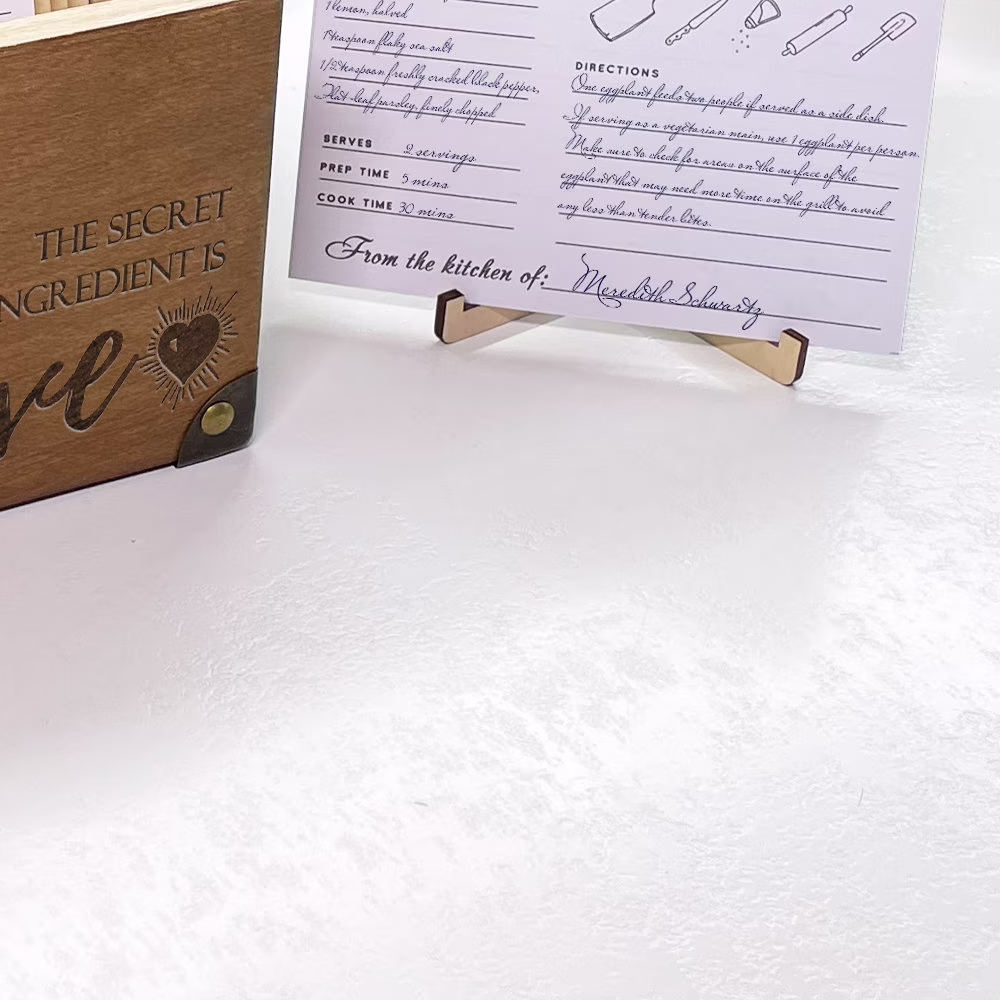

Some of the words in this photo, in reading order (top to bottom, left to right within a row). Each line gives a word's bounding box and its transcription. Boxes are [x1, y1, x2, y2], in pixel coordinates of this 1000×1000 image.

[372, 0, 414, 19] halved
[328, 29, 376, 51] teaspoon
[372, 30, 406, 58] flaky
[410, 43, 426, 51] sea
[429, 37, 454, 54] salt
[320, 57, 338, 72] 1/2
[338, 60, 385, 82] teaspoon
[382, 61, 426, 90] freshly
[428, 68, 474, 85] cracked
[471, 70, 504, 89] black
[496, 80, 540, 99] pepper,
[575, 61, 660, 78] DIRECTIONS
[415, 95, 453, 122] finely
[455, 100, 502, 125] chopped
[570, 72, 598, 91] One
[598, 80, 653, 104] eggplant
[646, 83, 684, 108] feeds
[684, 90, 706, 103] two
[701, 91, 745, 115] people
[743, 93, 763, 119] if
[759, 98, 805, 113] served
[829, 103, 855, 120] side
[562, 102, 591, 130] If
[588, 116, 633, 136] serving
[663, 121, 725, 141] vegetarian
[728, 131, 764, 141] main,
[797, 133, 854, 156] eggplant
[846, 141, 872, 159] per
[869, 144, 920, 162] person.
[323, 134, 372, 148] SERVES
[403, 143, 413, 155] 2
[416, 149, 476, 172] servings
[565, 128, 603, 160] Make
[606, 148, 632, 156] sure
[633, 146, 646, 159] to
[649, 145, 683, 162] check
[675, 147, 700, 172] for
[702, 160, 736, 168] areas
[737, 163, 753, 171] on
[755, 156, 775, 173] the
[778, 160, 821, 186] surface
[823, 165, 842, 189] of
[838, 166, 858, 182] the
[320, 162, 352, 174] PREP
[360, 167, 390, 179] TIME
[401, 173, 409, 184] 5
[412, 177, 449, 189] mins
[560, 166, 610, 190] eggplant
[610, 170, 641, 188] that
[641, 183, 668, 201] may
[671, 179, 704, 195] need
[701, 189, 731, 199] more
[733, 187, 763, 202] time
[766, 196, 781, 204] on
[782, 190, 803, 207] the
[799, 194, 840, 218] grill
[834, 200, 847, 211] to
[851, 201, 892, 216] avoid
[35, 220, 99, 262] THE
[107, 187, 233, 246] SECRET
[317, 193, 355, 206] COOK
[363, 199, 393, 210] TIME
[399, 202, 415, 214] 30
[417, 208, 455, 220] mins
[557, 202, 579, 220] any
[582, 197, 605, 214] less
[606, 200, 637, 216] than
[637, 206, 676, 222] tender
[680, 208, 712, 227] bites.
[201, 240, 227, 274] IS
[324, 235, 399, 267] From
[405, 250, 436, 272] the
[441, 253, 513, 282] kitchen
[519, 264, 549, 291] of:
[572, 253, 673, 309] Meredith
[669, 281, 764, 331] Schwartz
